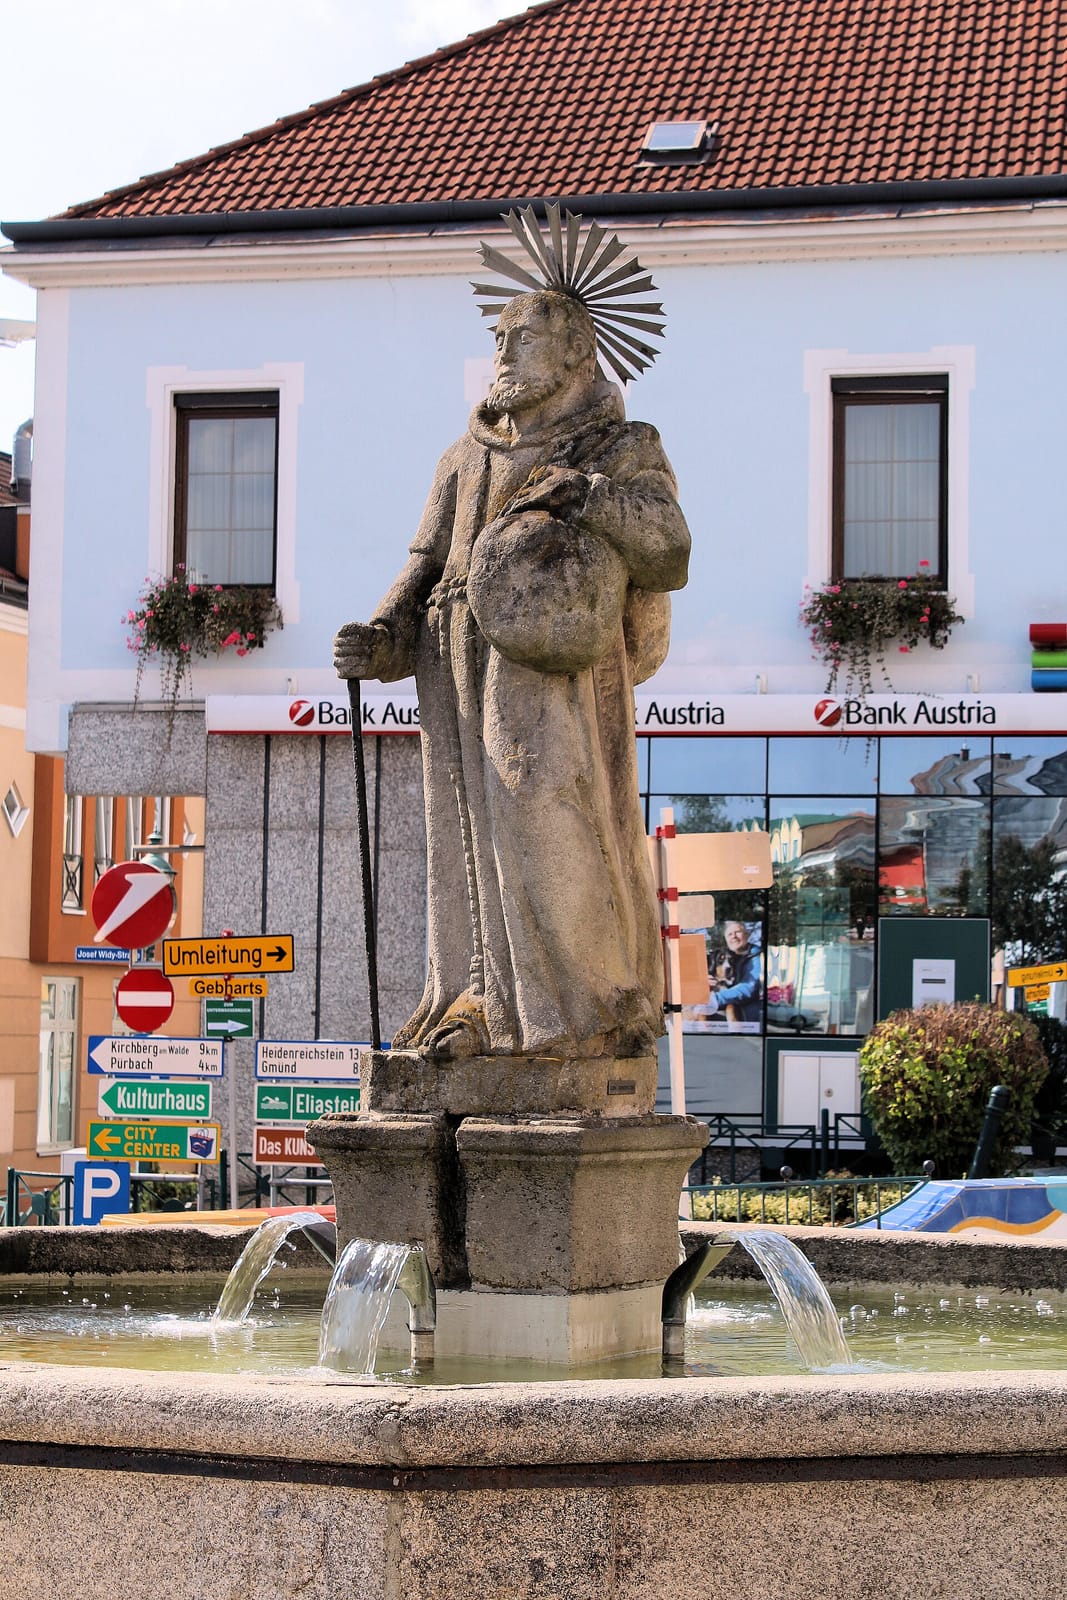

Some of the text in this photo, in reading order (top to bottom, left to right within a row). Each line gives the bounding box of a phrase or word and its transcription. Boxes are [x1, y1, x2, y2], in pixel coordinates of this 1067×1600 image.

[319, 702, 375, 724] Bak
[645, 701, 725, 725] Austria
[846, 701, 996, 724] Bank Austria
[77, 949, 97, 959] Josef
[169, 945, 262, 968] Umleitung
[194, 980, 263, 995] Gebharts
[111, 1041, 159, 1057] Kirchberg
[168, 1045, 190, 1055] Walde
[262, 1046, 359, 1060] Heidenreichstein 13
[261, 1060, 359, 1075] Gmünd 8
[117, 1086, 206, 1111] Kulturhaus
[124, 1126, 157, 1141] CITY
[123, 1142, 180, 1157] CENTER
[260, 1136, 281, 1156] Das
[83, 1168, 120, 1218] P
